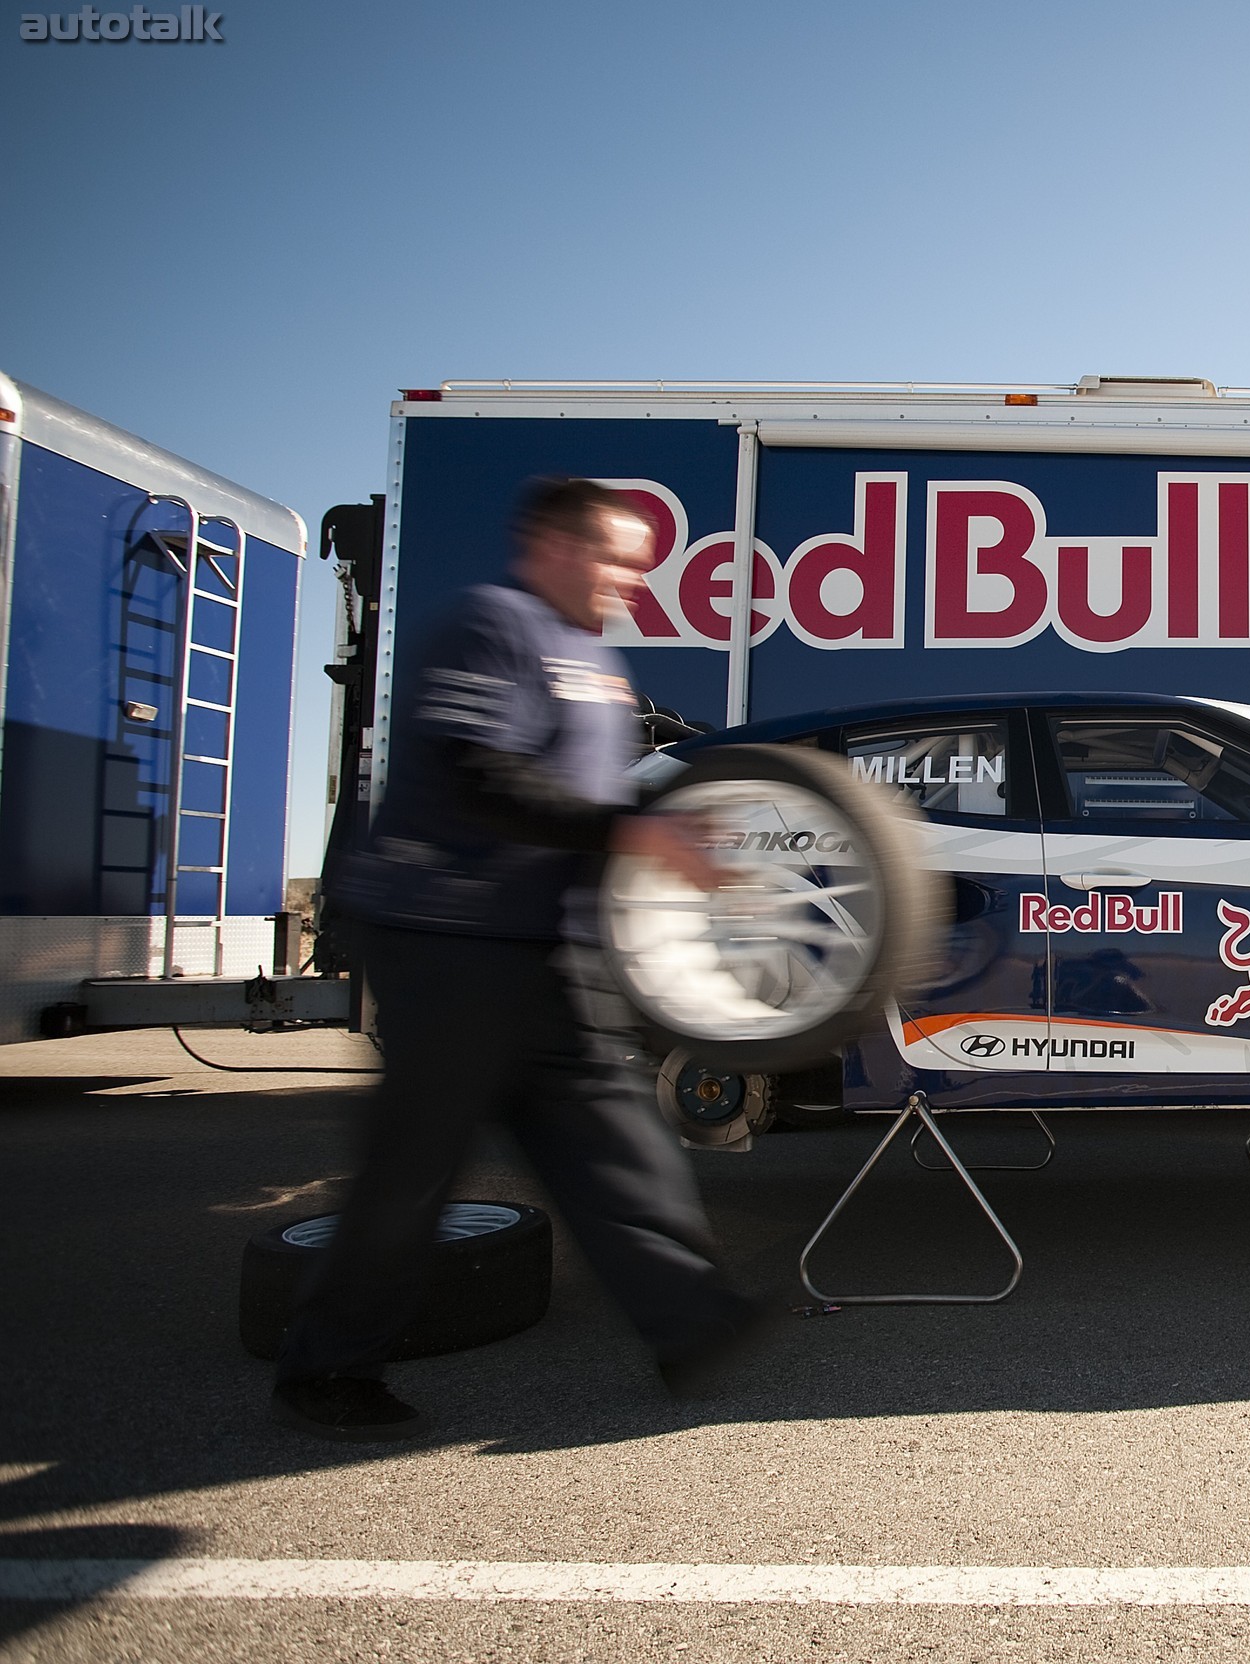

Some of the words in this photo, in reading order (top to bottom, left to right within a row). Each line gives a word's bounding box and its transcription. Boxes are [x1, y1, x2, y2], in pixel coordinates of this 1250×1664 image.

[851, 756, 1003, 783] MILLEN
[1020, 891, 1101, 933] Red
[1105, 892, 1183, 934] Bull
[1012, 1038, 1135, 1058] HYUNDAI
